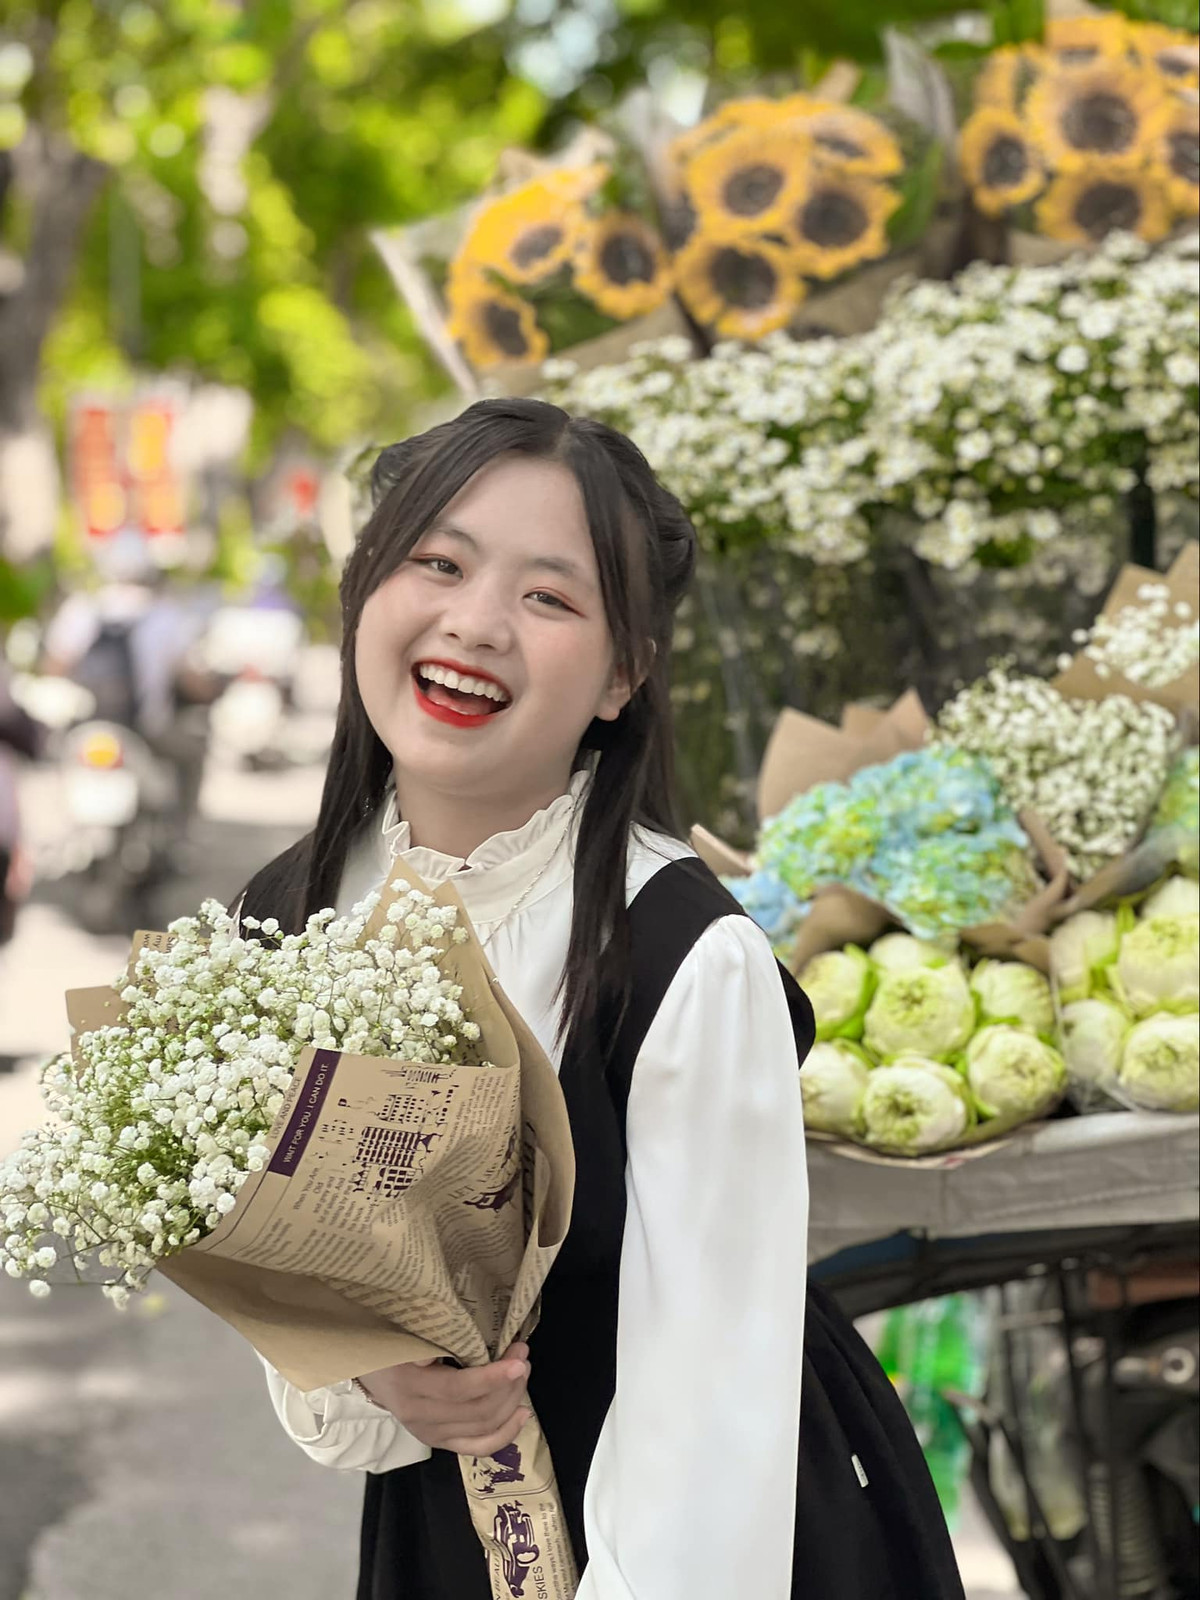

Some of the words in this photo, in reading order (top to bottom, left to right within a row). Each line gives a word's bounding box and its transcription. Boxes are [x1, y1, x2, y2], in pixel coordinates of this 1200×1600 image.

[270, 1122, 283, 1140] LOVE
[280, 1104, 292, 1119] AND
[287, 1077, 303, 1102] PEACE
[284, 1142, 298, 1163] WAIT
[292, 1129, 304, 1144] FOR
[300, 1112, 311, 1127] YOU
[309, 1086, 320, 1103] CAN
[315, 1073, 325, 1085] DO
[532, 1566, 548, 1600] SKIES
